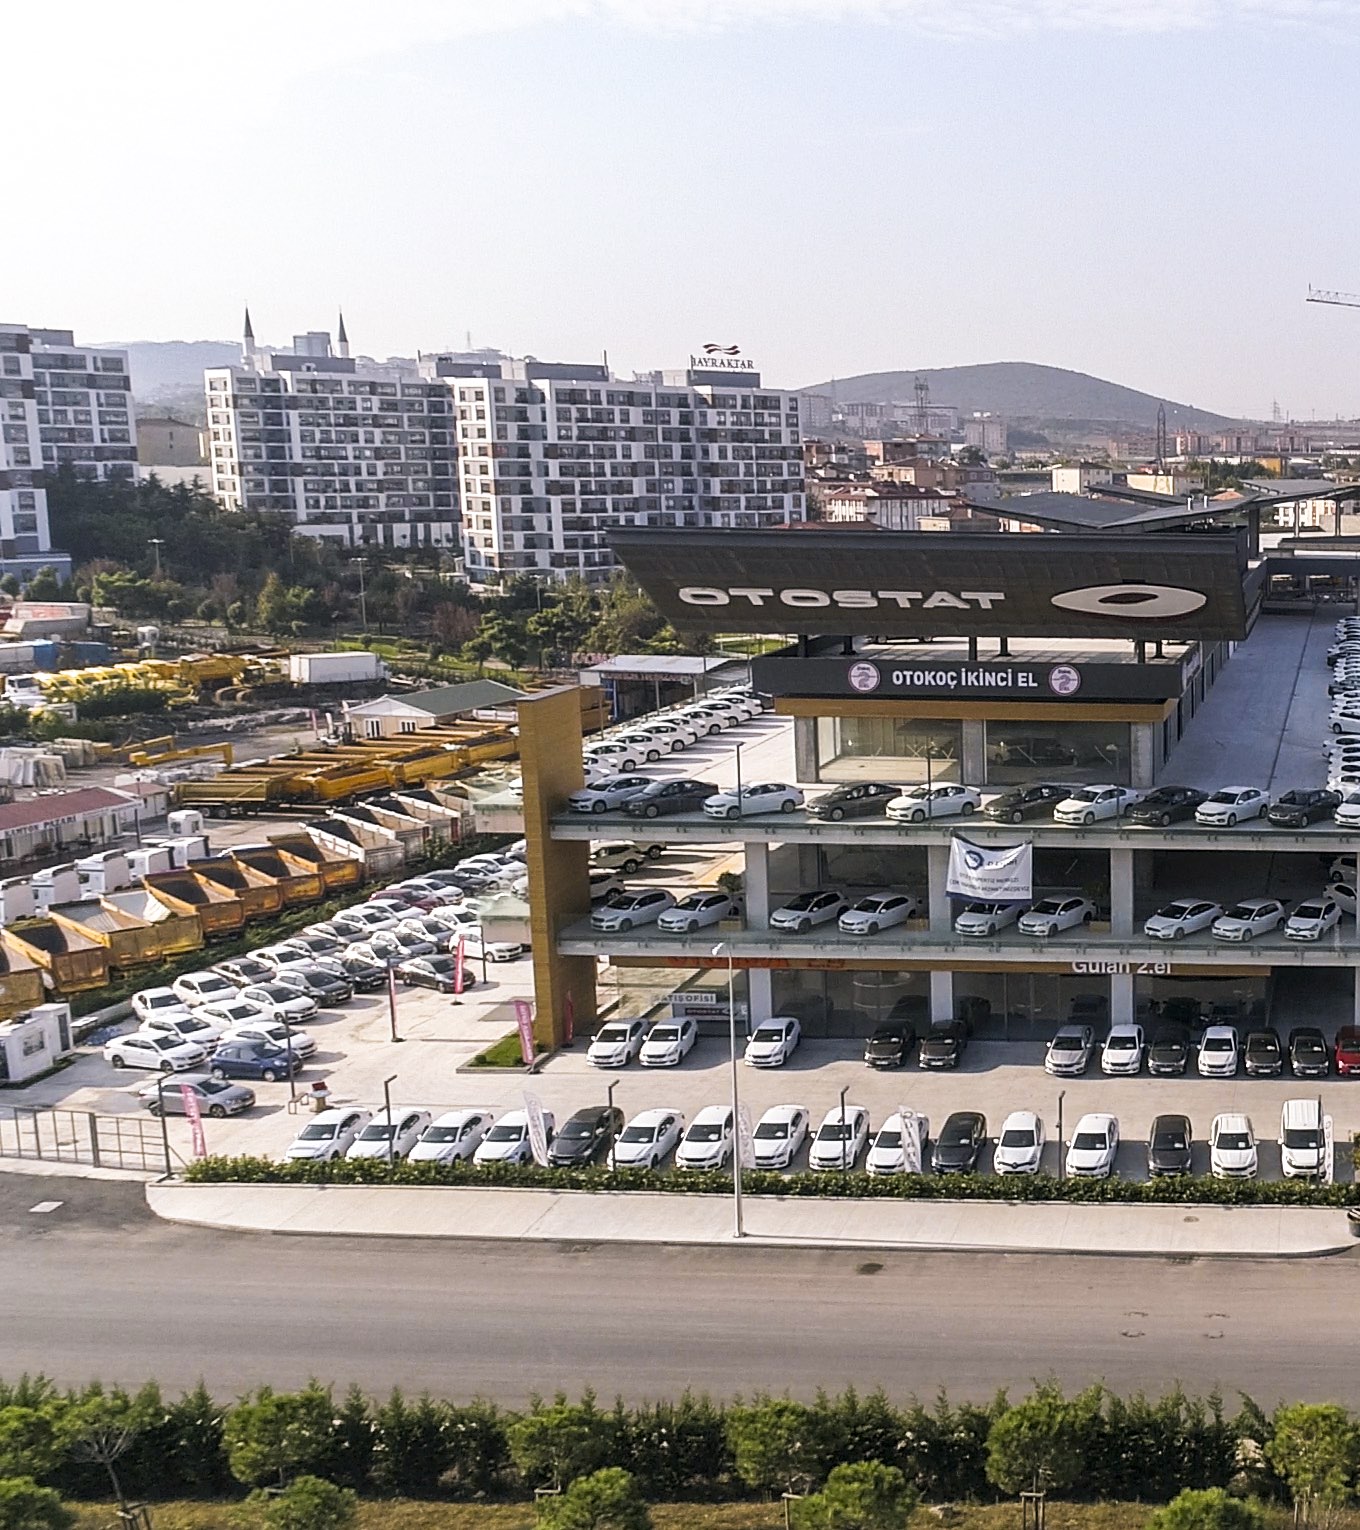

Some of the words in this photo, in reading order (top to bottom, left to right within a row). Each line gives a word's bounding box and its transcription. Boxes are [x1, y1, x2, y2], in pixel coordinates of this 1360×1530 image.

[678, 586, 1006, 609] OTOSTAT
[892, 670, 957, 689] OTOKOÇ
[961, 668, 1012, 687] İKİNCİ
[1018, 672, 1038, 687] EL
